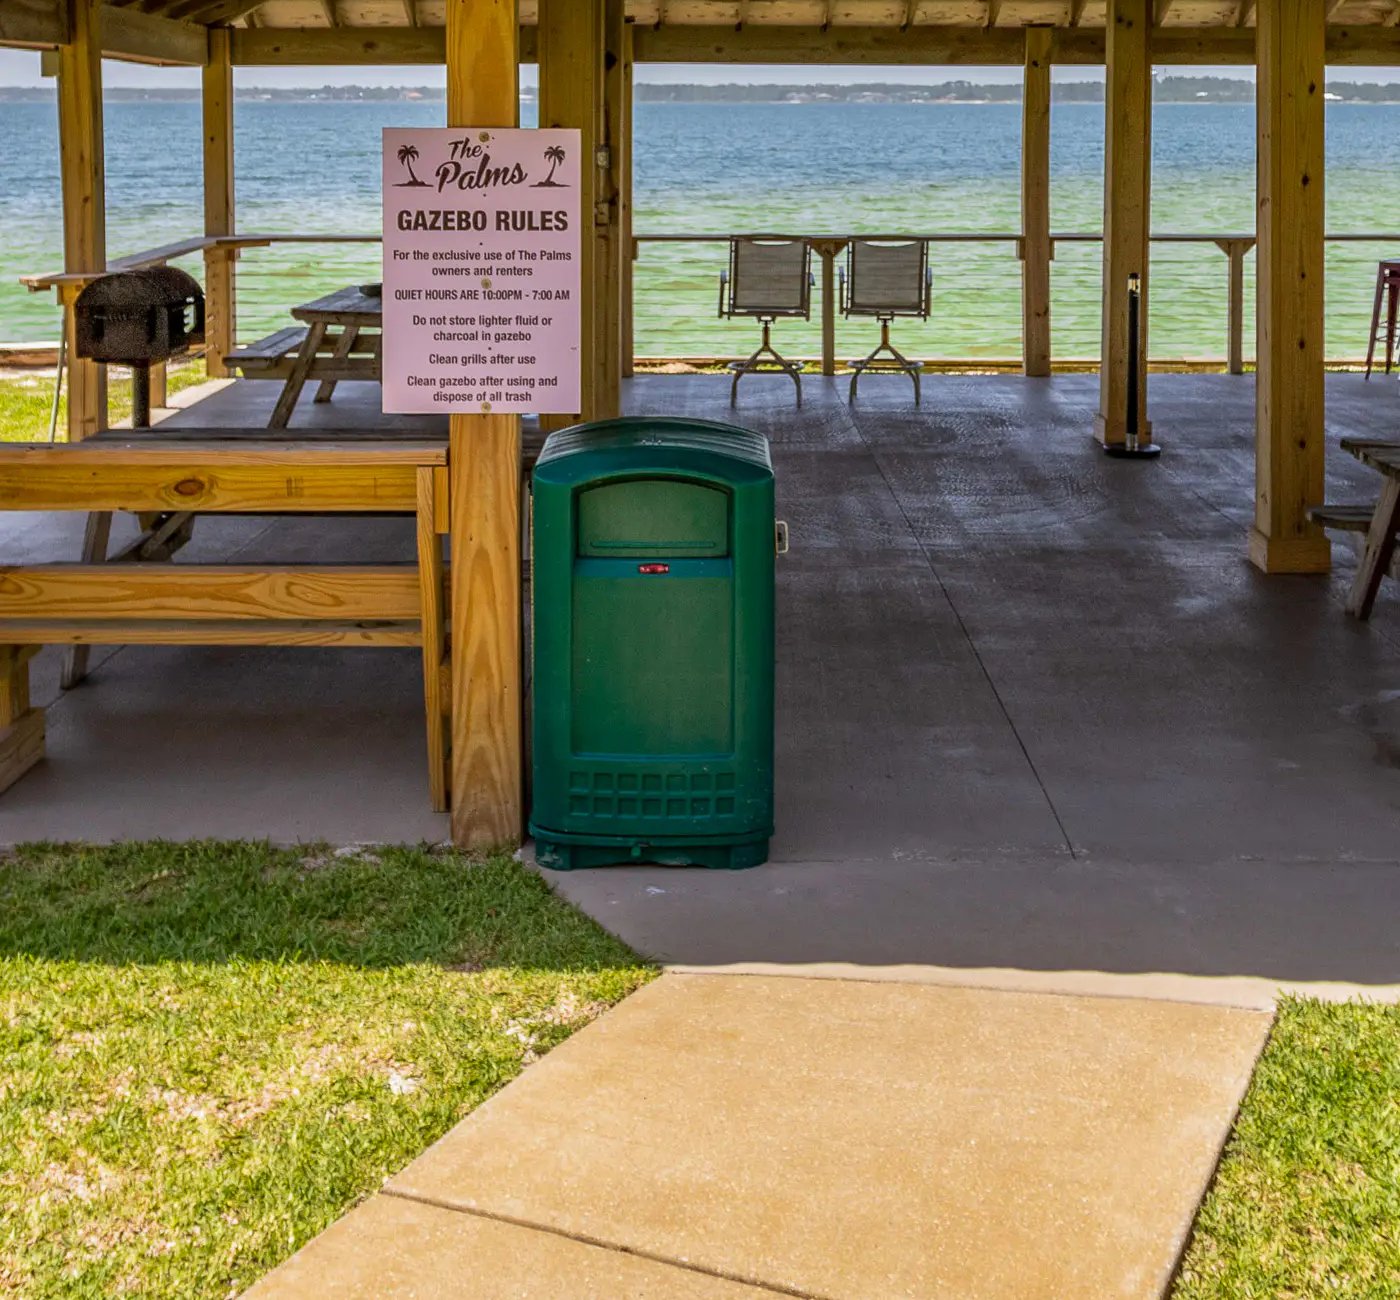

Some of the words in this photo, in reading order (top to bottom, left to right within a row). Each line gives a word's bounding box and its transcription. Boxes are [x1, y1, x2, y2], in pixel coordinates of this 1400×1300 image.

[448, 136, 483, 160] The
[435, 153, 528, 193] Palms
[397, 210, 487, 231] GAZEBO
[496, 210, 568, 231] RULES
[393, 250, 409, 260] For
[413, 250, 429, 260] the
[433, 250, 480, 260] exclusive
[484, 252, 502, 260] use
[506, 250, 515, 260] of
[518, 250, 536, 260] The
[540, 250, 572, 261] Palms
[432, 268, 470, 276] owners
[474, 266, 492, 276] and
[496, 267, 533, 276] renters
[395, 290, 422, 301] QUIET
[425, 290, 458, 300] HOURS
[460, 290, 478, 300] ARE
[483, 290, 522, 300] 10:00PM
[533, 290, 552, 300] 7:00
[555, 290, 570, 300] AM
[413, 315, 426, 325] Do
[430, 316, 446, 325] not
[450, 316, 475, 325] store
[479, 315, 513, 327] lighter
[516, 315, 538, 325] fluid
[542, 317, 552, 325] or
[433, 331, 478, 341] charcoal
[482, 331, 491, 341] in
[495, 331, 531, 343] gazebo
[429, 354, 458, 364] Clean
[461, 354, 487, 366] grills
[490, 354, 514, 364] after
[518, 356, 536, 364] use
[407, 376, 435, 386] Clean
[440, 376, 476, 388] gazebo
[480, 376, 504, 386] after
[507, 376, 535, 388] using
[539, 376, 557, 386] and
[433, 392, 473, 403] dispose
[476, 392, 487, 401] of
[490, 392, 502, 401] all
[505, 392, 532, 401] trash
